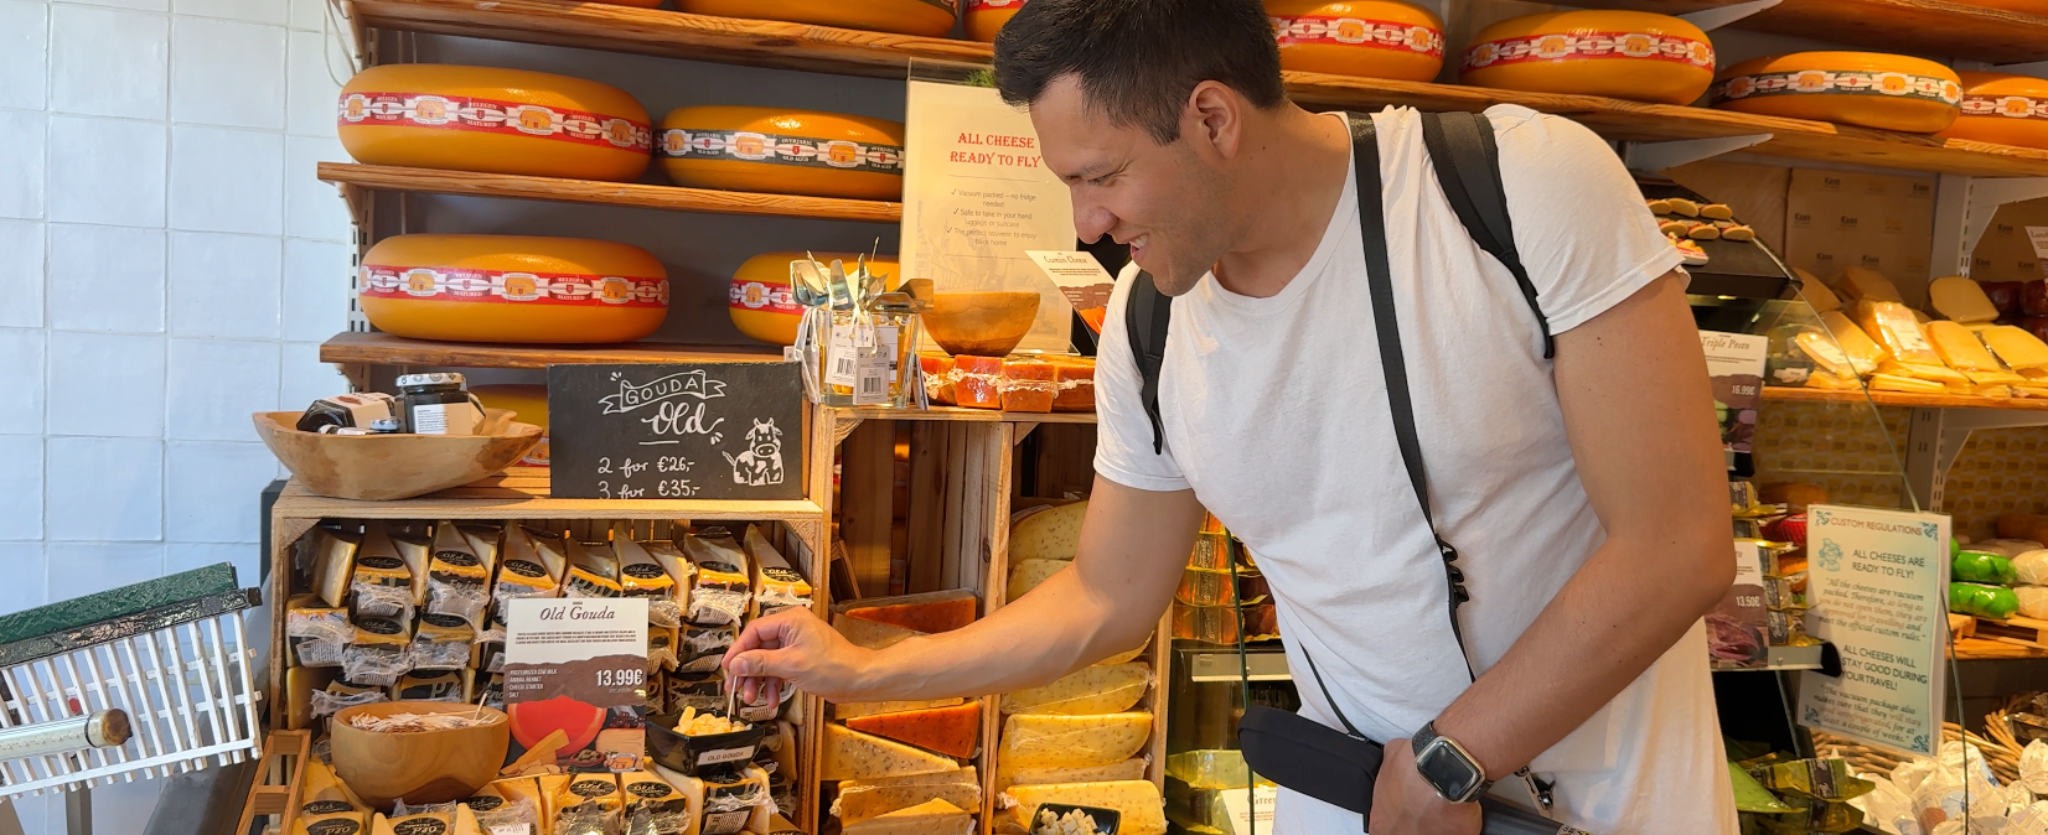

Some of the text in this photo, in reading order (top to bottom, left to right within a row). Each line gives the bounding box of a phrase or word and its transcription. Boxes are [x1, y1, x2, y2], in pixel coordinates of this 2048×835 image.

[958, 132, 1035, 149] ALL CHEESE
[950, 150, 1042, 168] READY TO FLY
[958, 189, 982, 198] Vacuum
[982, 191, 1004, 200] packed
[1020, 192, 1036, 202] fridge
[982, 200, 1004, 208] needed
[960, 208, 974, 216] Safe
[982, 210, 996, 218] take
[1003, 212, 1017, 222] your
[1018, 212, 1032, 220] hand
[964, 218, 988, 228] luggage
[996, 220, 1020, 228] suitcase
[966, 228, 987, 237] perfect
[988, 230, 1012, 238] souvenir
[1021, 232, 1037, 240] enjoy
[990, 238, 1008, 246] home
[1700, 336, 1750, 351] Triple Pesto
[625, 376, 699, 404] GOUDA
[640, 401, 725, 435] Old
[598, 456, 614, 474] 2
[618, 458, 649, 478] for
[598, 480, 611, 500] 3
[617, 484, 646, 500] for
[1830, 517, 1922, 536] CUSTOM REGULATIONS
[1852, 549, 1925, 567] ALL CHEESES ARE
[1852, 562, 1914, 579] READY TO FLY!
[1840, 579, 1851, 588] the
[1852, 582, 1877, 594] cheeses
[1878, 587, 1891, 596] are
[1892, 590, 1924, 601] vacuum
[1736, 595, 1761, 608] 13.50€
[1822, 588, 1848, 599] packed.
[1850, 592, 1886, 605] Therefore,
[1896, 600, 1914, 612] long
[1914, 604, 1924, 612] as
[540, 605, 616, 620] Old Gouda
[1842, 600, 1854, 609] not
[1856, 603, 1872, 613] open
[1895, 610, 1912, 621] they
[1914, 614, 1928, 623] are
[1836, 618, 1847, 627] the
[1848, 621, 1873, 632] official
[1874, 626, 1900, 637] custom
[1906, 623, 1922, 632] and
[1842, 644, 1916, 668] ALL CHEESES WILL
[596, 668, 643, 686] 13.99€
[1842, 656, 1928, 684] STAY GOOD DURING
[1866, 674, 1898, 691] TRAVEL!
[1840, 690, 1868, 703] vacuum
[1870, 698, 1898, 712] package
[1900, 704, 1916, 714] also
[1854, 704, 1869, 713] that
[1871, 707, 1888, 718] they
[1848, 722, 1872, 734] couple
[1872, 728, 1881, 738] of
[1892, 722, 1905, 732] for
[1906, 727, 1914, 735] at
[708, 754, 720, 762] OLD
